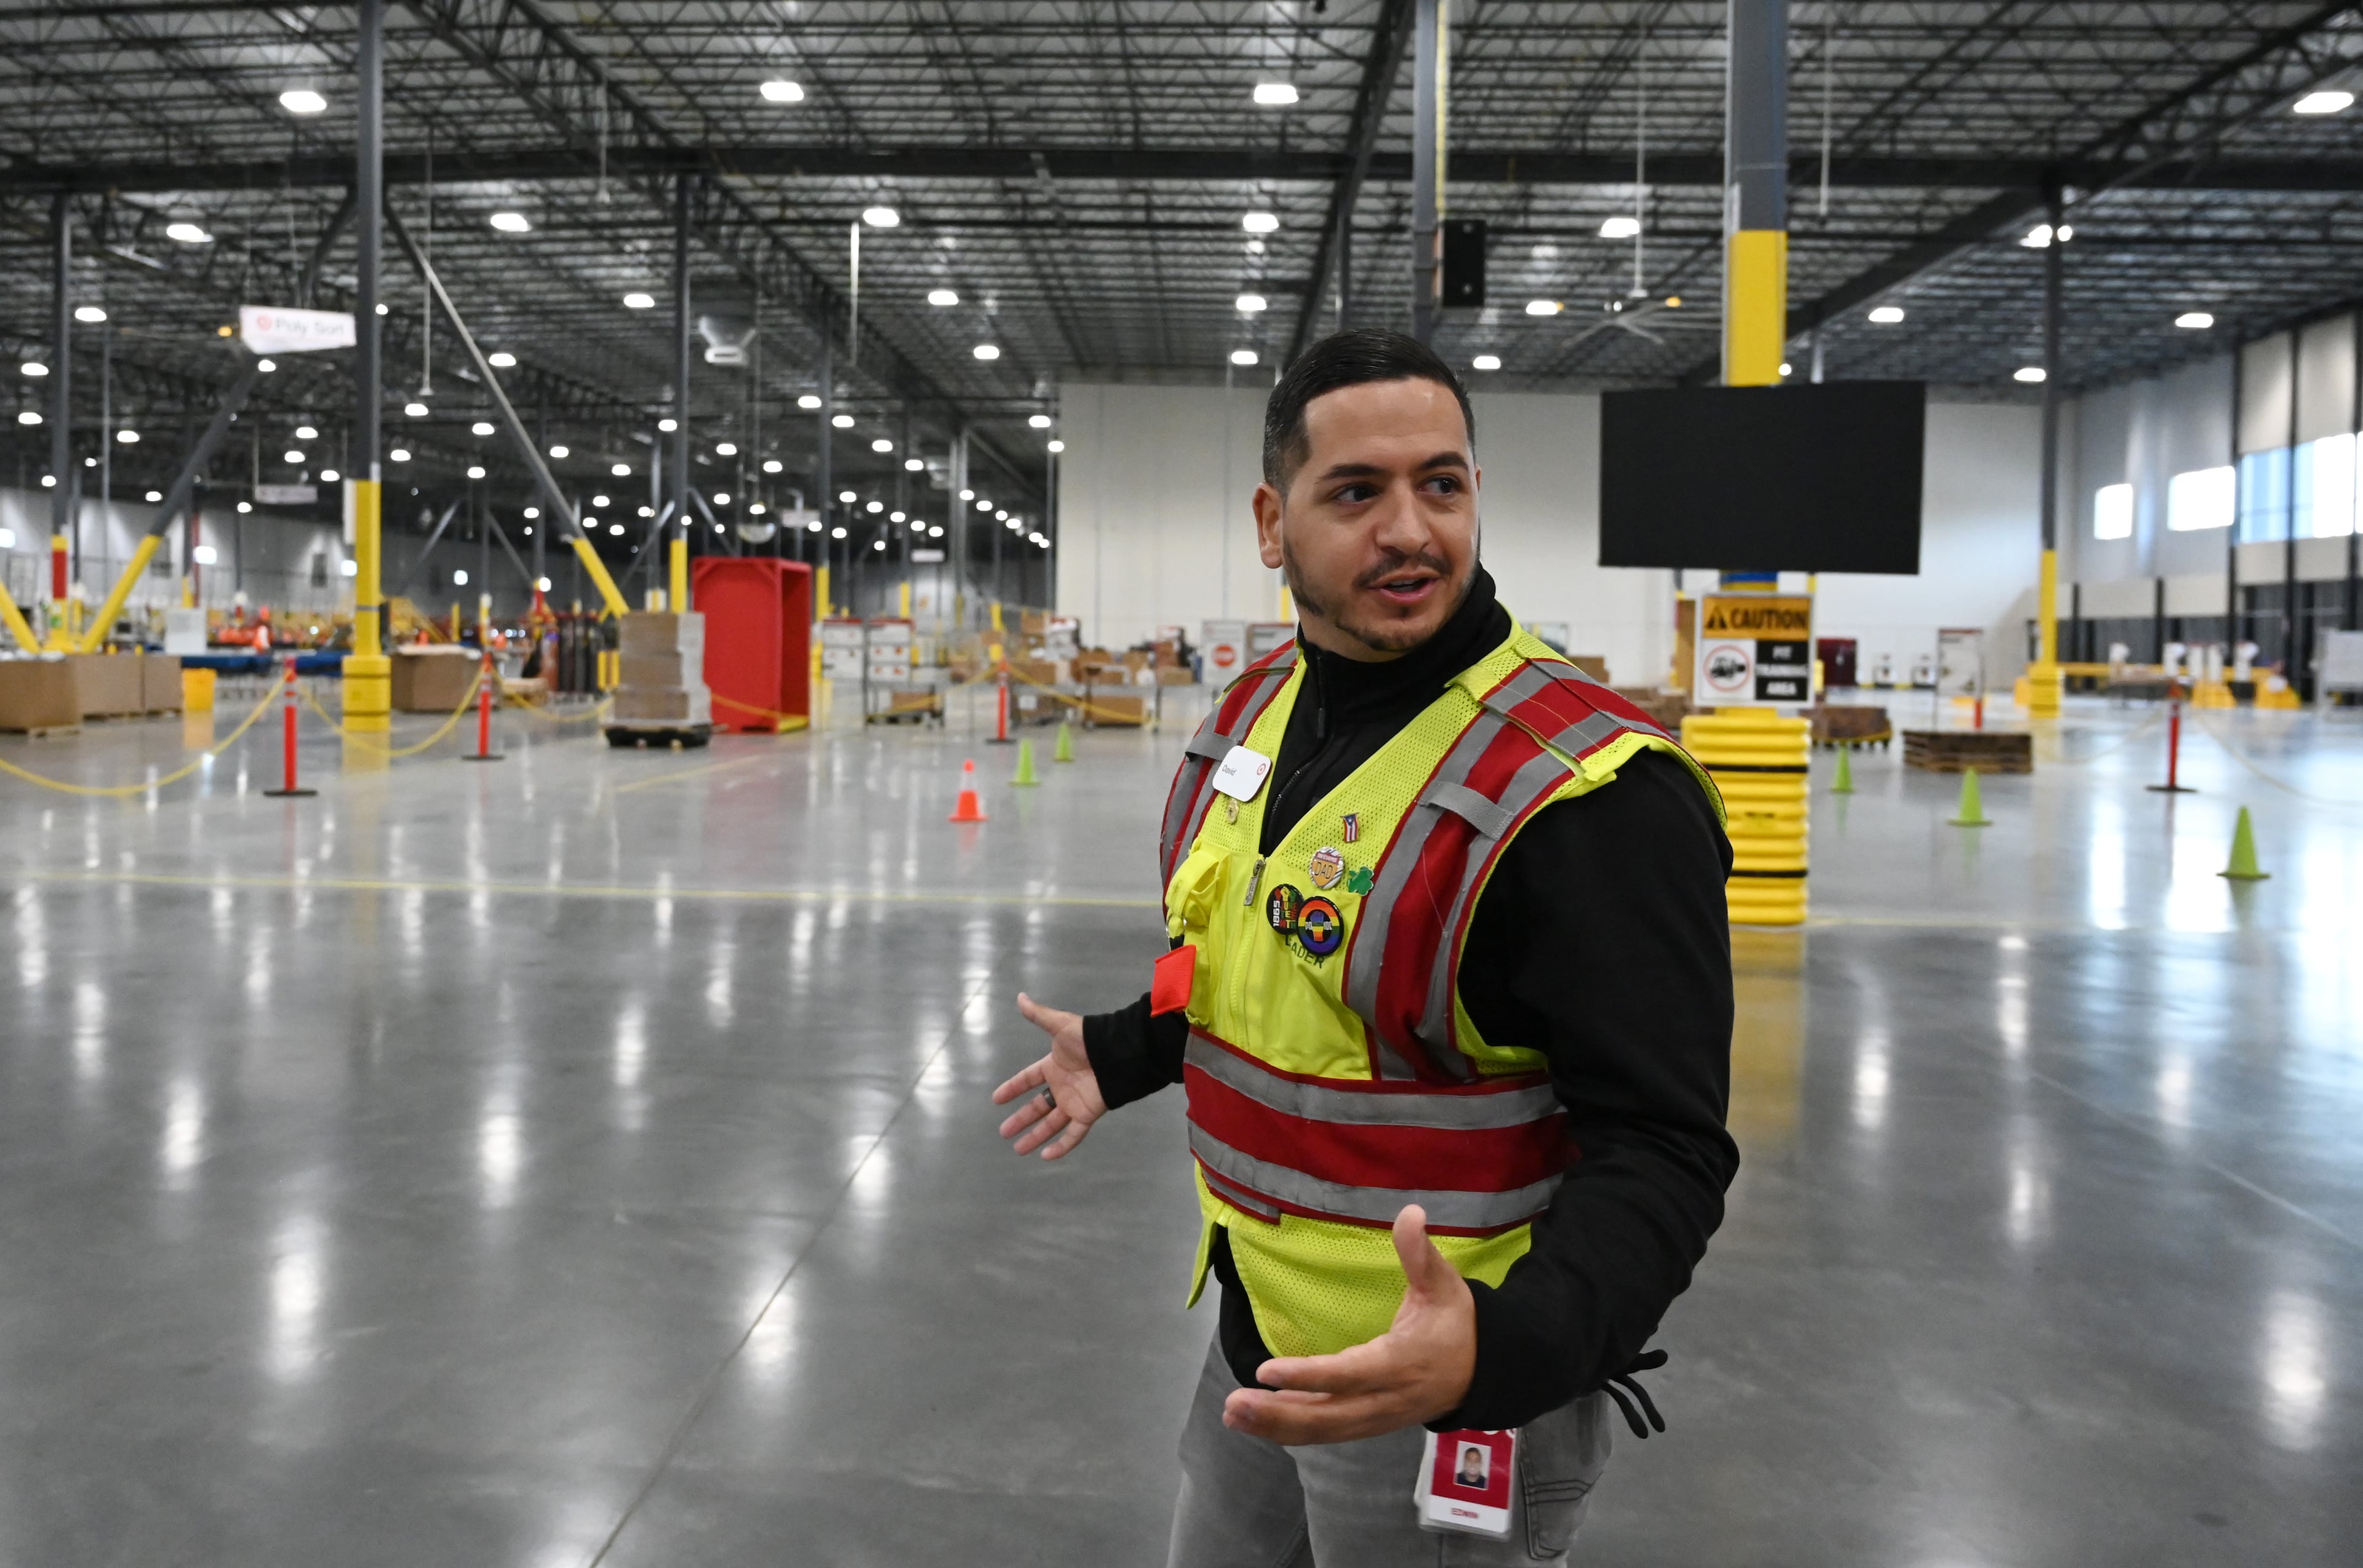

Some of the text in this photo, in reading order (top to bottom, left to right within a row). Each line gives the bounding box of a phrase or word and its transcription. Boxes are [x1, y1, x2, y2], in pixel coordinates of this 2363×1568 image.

[1730, 607, 1809, 630] CAUTION
[1221, 764, 1237, 775] David
[1314, 862, 1333, 879] DAD
[1273, 900, 1281, 927] 1865
